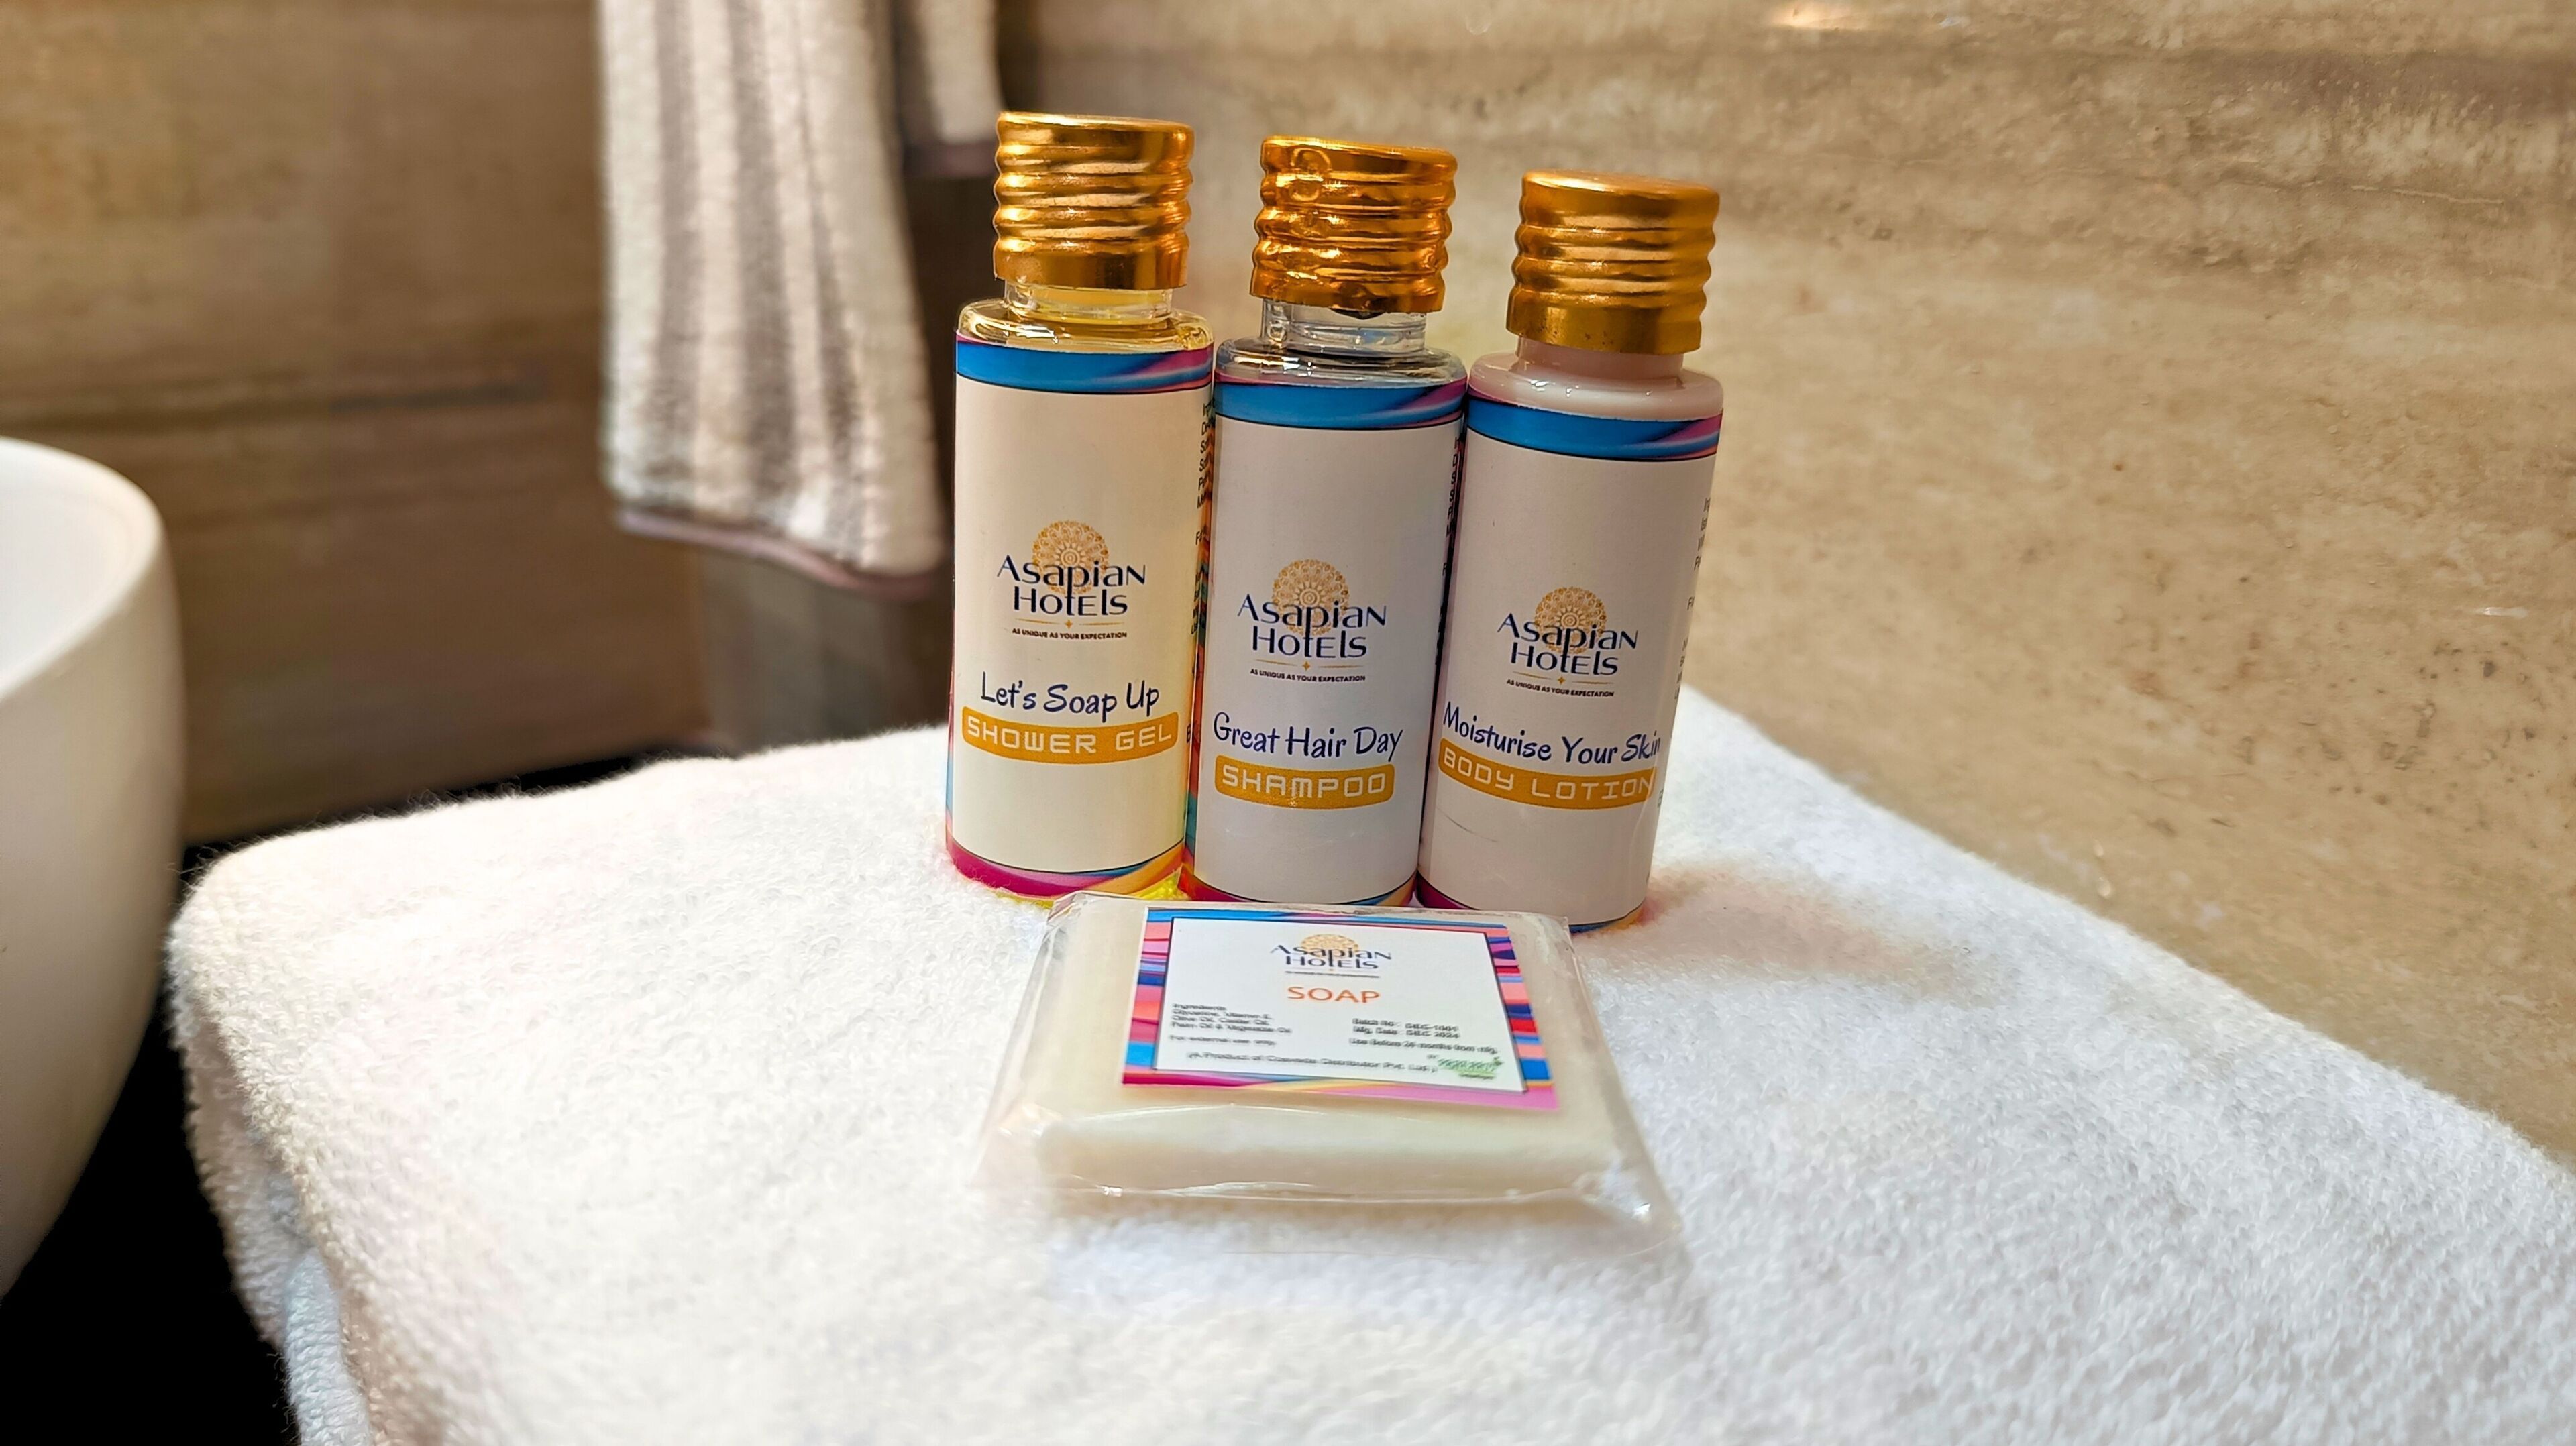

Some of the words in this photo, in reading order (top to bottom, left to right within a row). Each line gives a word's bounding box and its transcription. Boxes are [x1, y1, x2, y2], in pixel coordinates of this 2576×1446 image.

[1022, 630, 1048, 638] UNIQUE
[981, 671, 1037, 710] Let's
[1043, 683, 1117, 722] Soap
[1126, 680, 1159, 717] Up
[967, 716, 1097, 754] SHOWER
[1116, 724, 1172, 750] GEL
[1214, 712, 1280, 754] Great
[1285, 726, 1347, 759] Hair
[1354, 726, 1403, 762] Day
[1443, 701, 1552, 761] Moisturise
[1562, 736, 1618, 764] Your
[1222, 765, 1385, 798] SHAMPOO
[1444, 746, 1515, 791] BODY
[1531, 777, 1654, 801] LOTION
[1287, 986, 1381, 1004] SOAP
